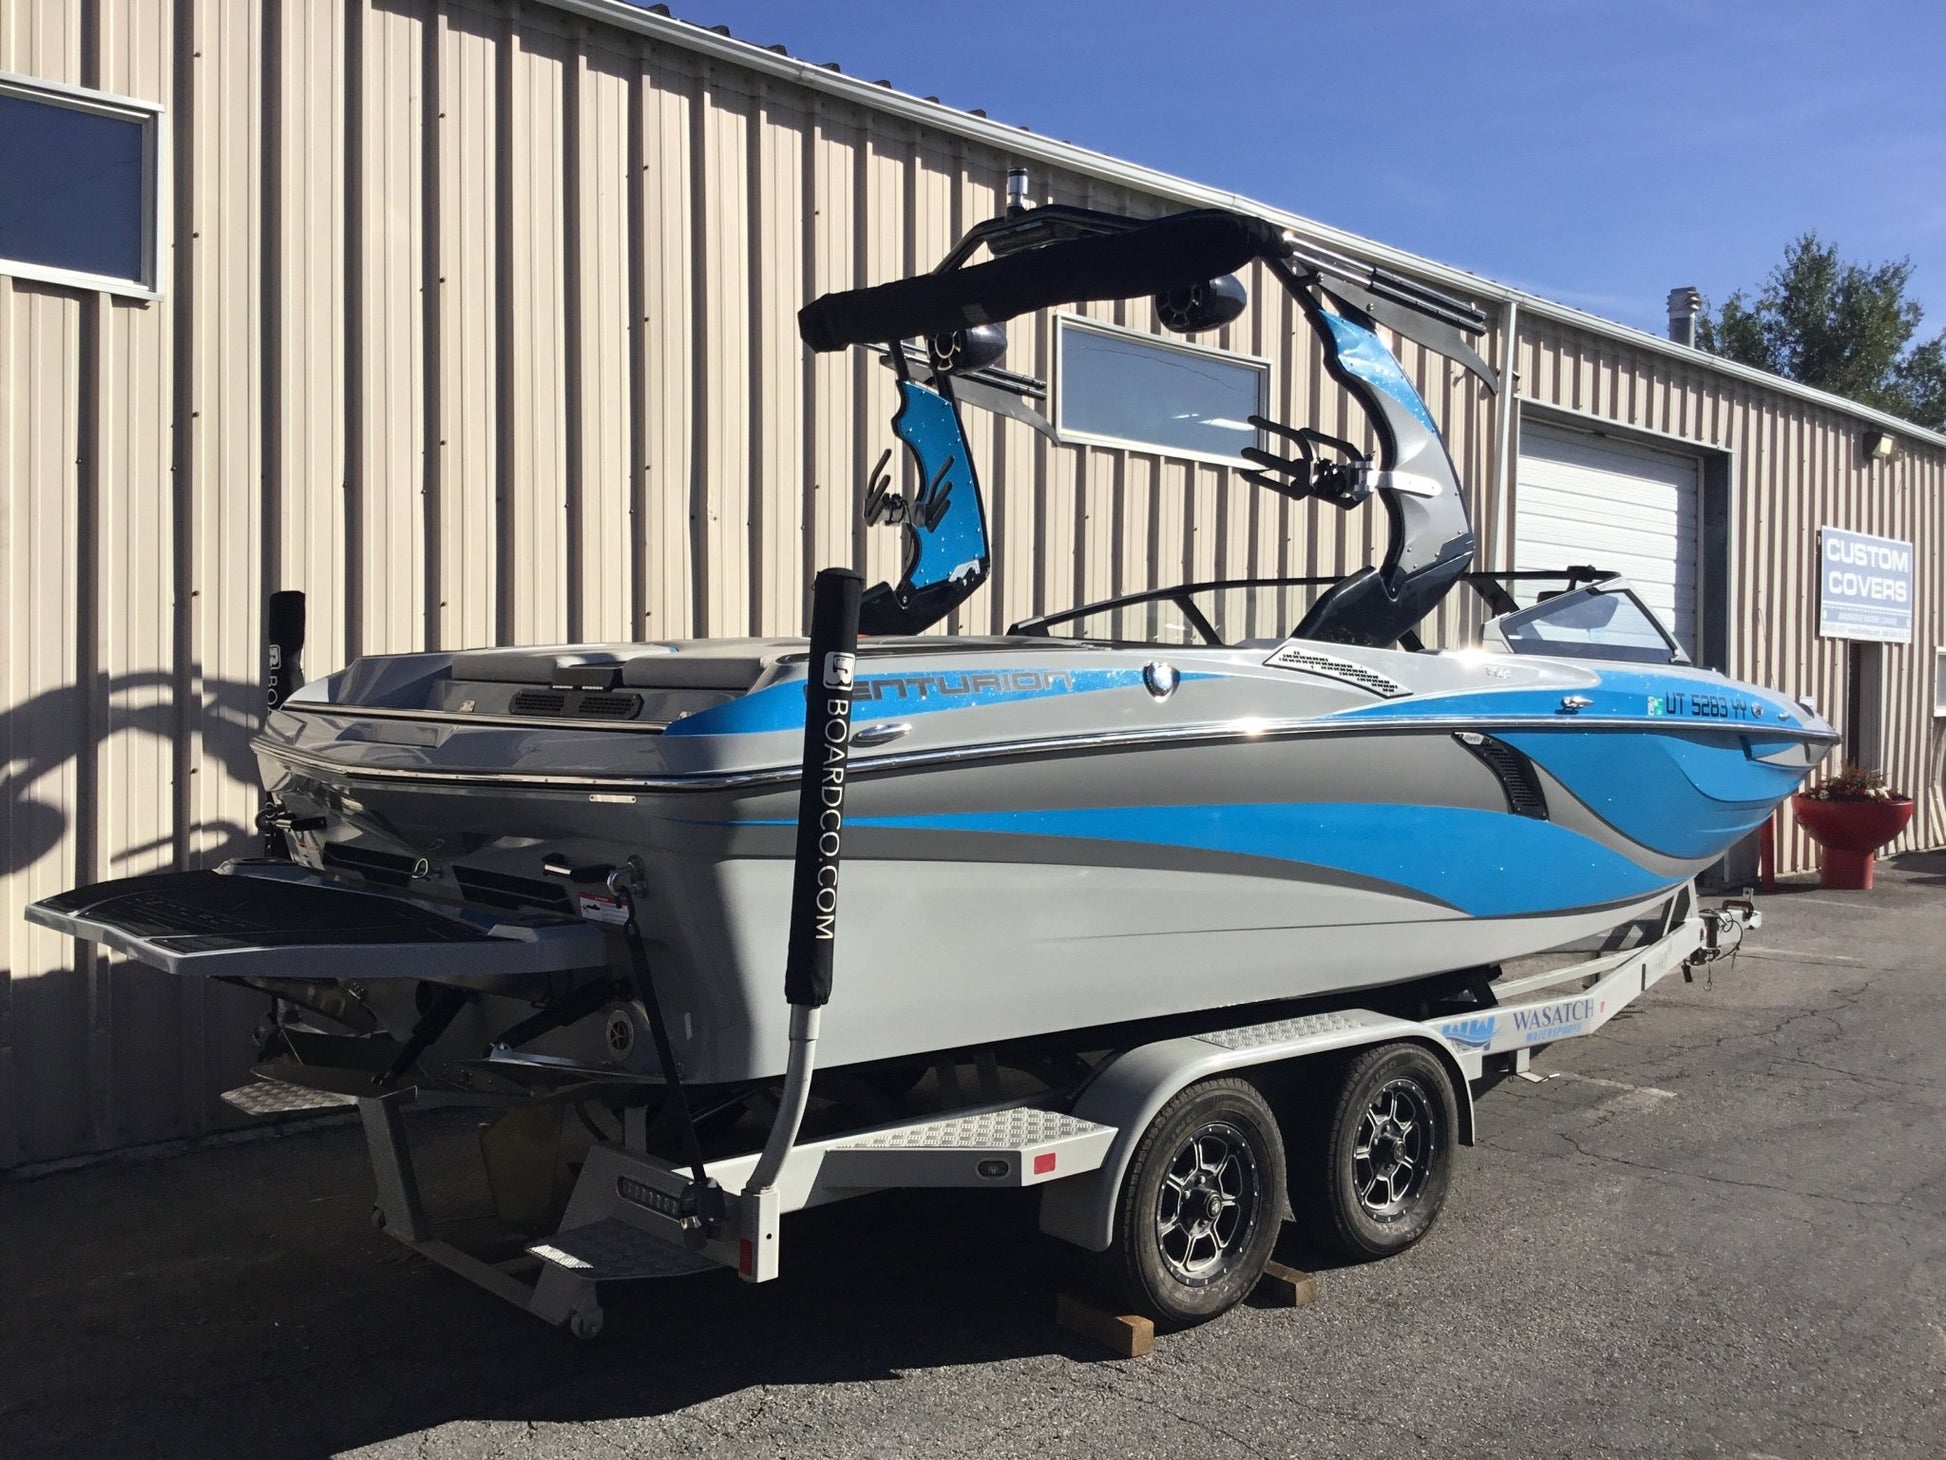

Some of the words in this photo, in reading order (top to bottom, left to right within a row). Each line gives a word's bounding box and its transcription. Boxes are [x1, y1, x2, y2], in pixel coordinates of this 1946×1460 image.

[1826, 537, 1909, 573] CUSTOM
[1828, 571, 1907, 603] COVERS
[803, 670, 1074, 703] ENTURION
[1666, 692, 1685, 715] UT
[1691, 694, 1729, 718] 5283
[815, 699, 849, 940] BOARDCO.COM
[1513, 998, 1595, 1032] WASATCH
